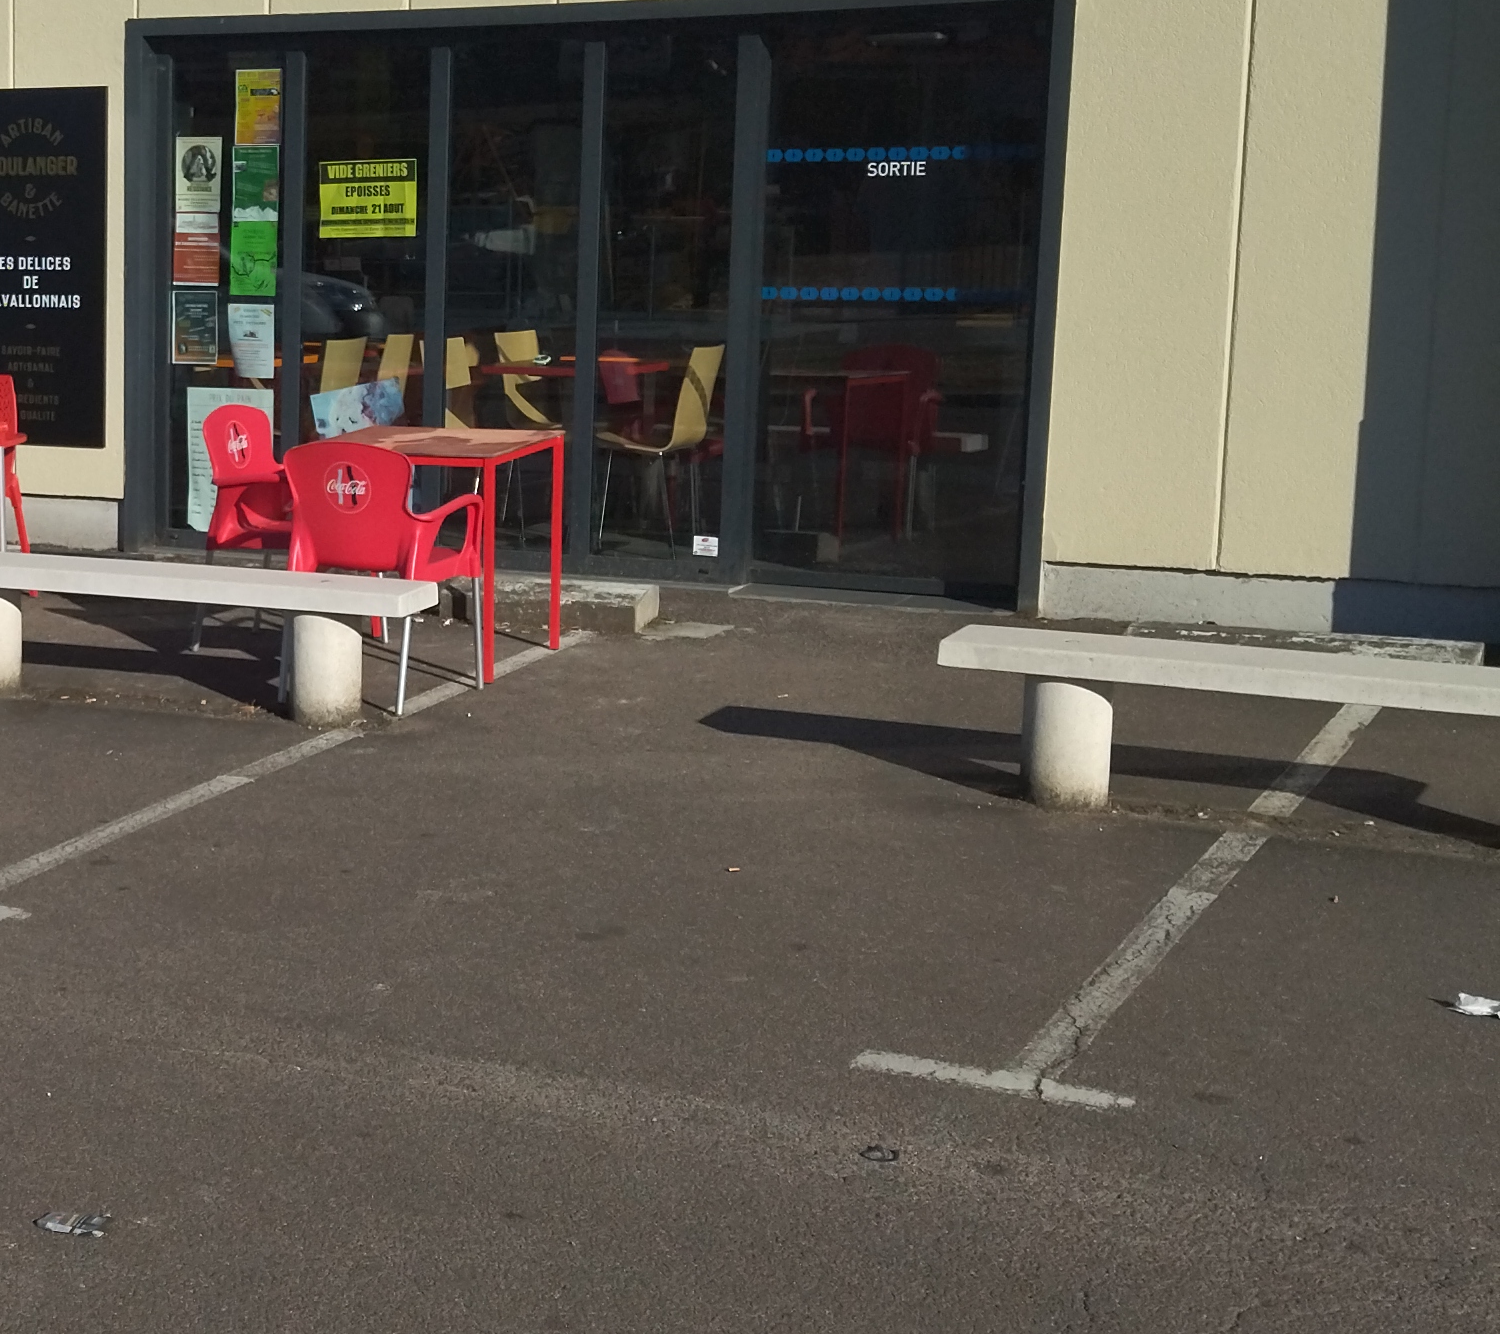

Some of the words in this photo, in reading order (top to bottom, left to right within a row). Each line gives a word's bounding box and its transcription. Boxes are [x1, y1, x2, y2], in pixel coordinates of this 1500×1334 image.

[0, 118, 64, 148] ARTISAN
[327, 165, 353, 179] VIDE
[356, 162, 408, 178] GRENIERS
[867, 161, 926, 177] SORTIE
[345, 185, 390, 197] EPOISSES
[0, 192, 63, 218] BANETTE
[331, 205, 368, 215] DIMANCHE
[372, 204, 381, 214] 21
[384, 203, 404, 214] AOUT
[18, 257, 71, 270] DELICES
[23, 276, 39, 289] DE
